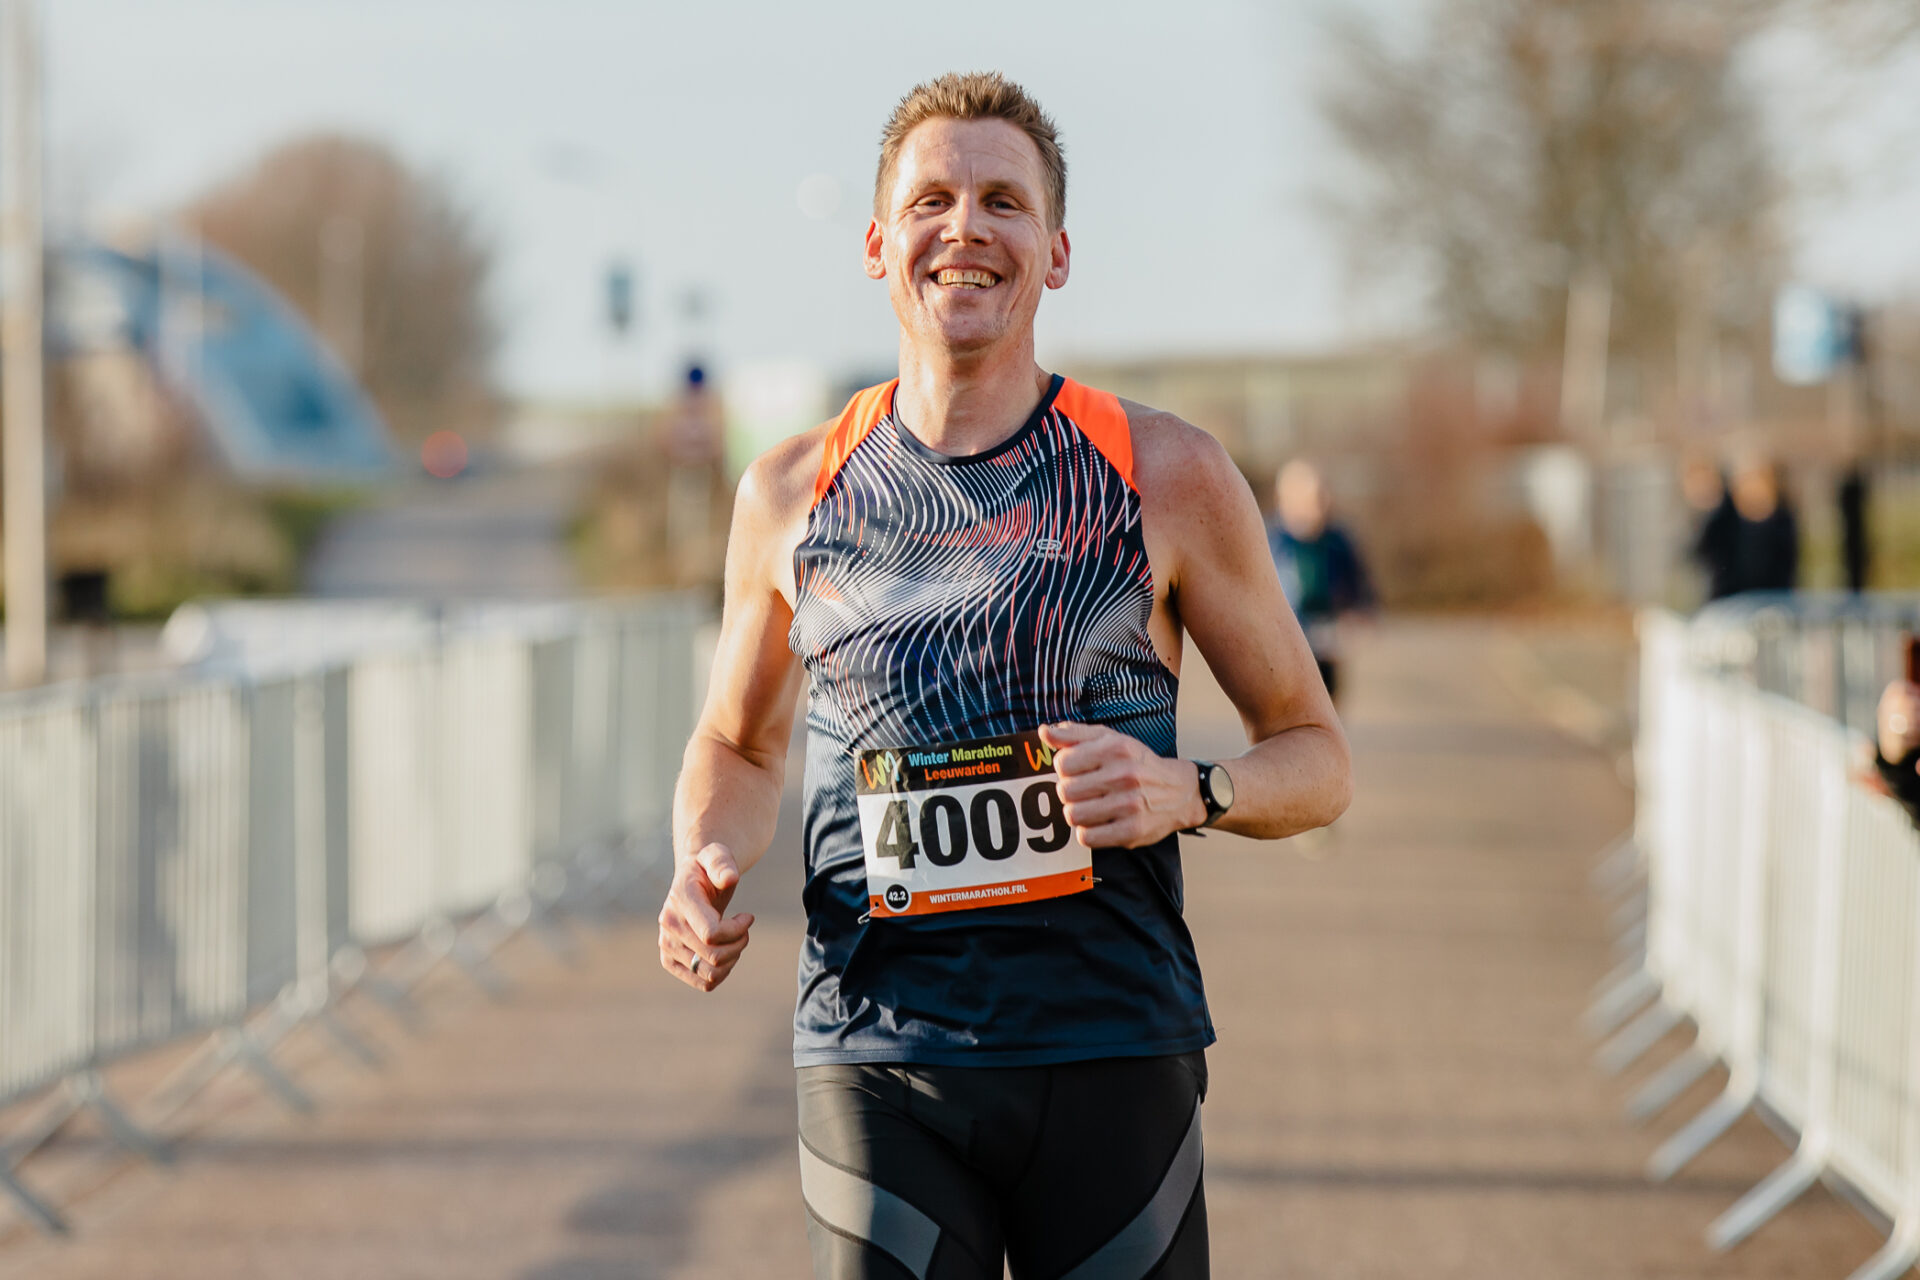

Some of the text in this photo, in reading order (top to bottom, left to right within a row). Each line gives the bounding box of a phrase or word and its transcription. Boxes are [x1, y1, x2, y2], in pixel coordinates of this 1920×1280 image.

[909, 744, 1013, 767] Winter Marathon
[924, 761, 1000, 782] Leeuwarden
[876, 781, 1071, 869] 4009
[888, 890, 907, 902] 42.2
[929, 884, 1028, 904] WINTERMARATHON.FRL
